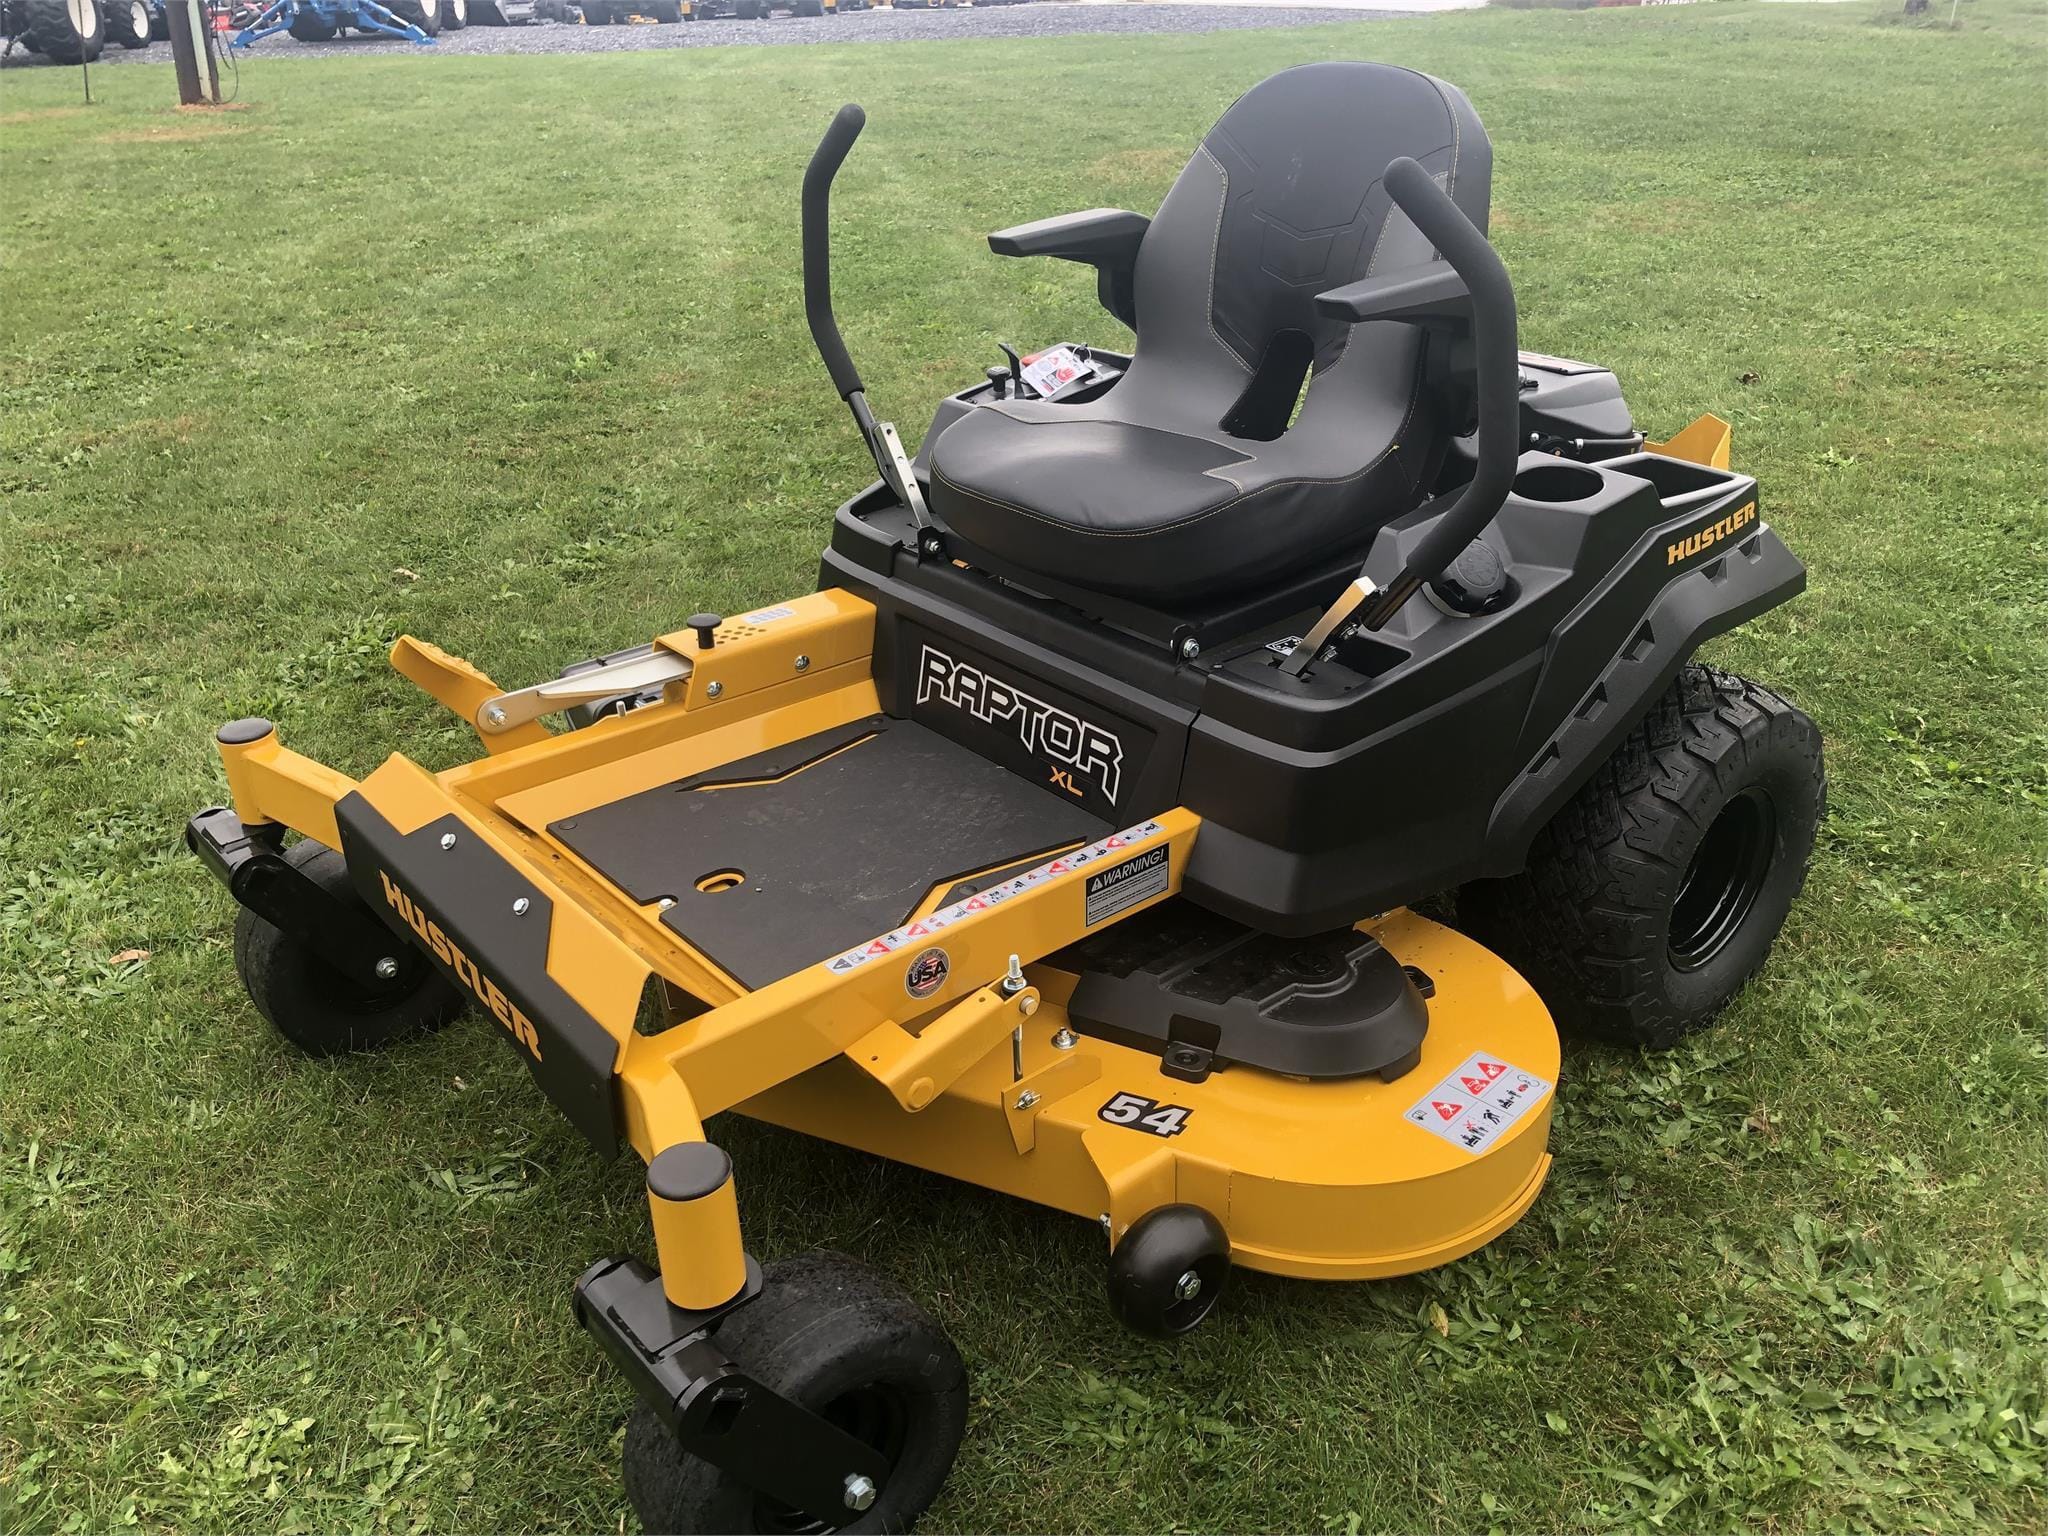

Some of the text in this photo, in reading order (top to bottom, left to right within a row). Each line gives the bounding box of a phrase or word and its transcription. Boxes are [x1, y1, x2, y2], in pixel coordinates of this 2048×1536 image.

[1667, 501, 1755, 566] HUSTLER
[916, 643, 1124, 807] RAPTOR
[1049, 765, 1084, 797] XL
[1103, 848, 1165, 887] WARNING!
[379, 869, 543, 1062] HUSTLER
[908, 960, 948, 987] USA
[1101, 1093, 1189, 1136] 54
